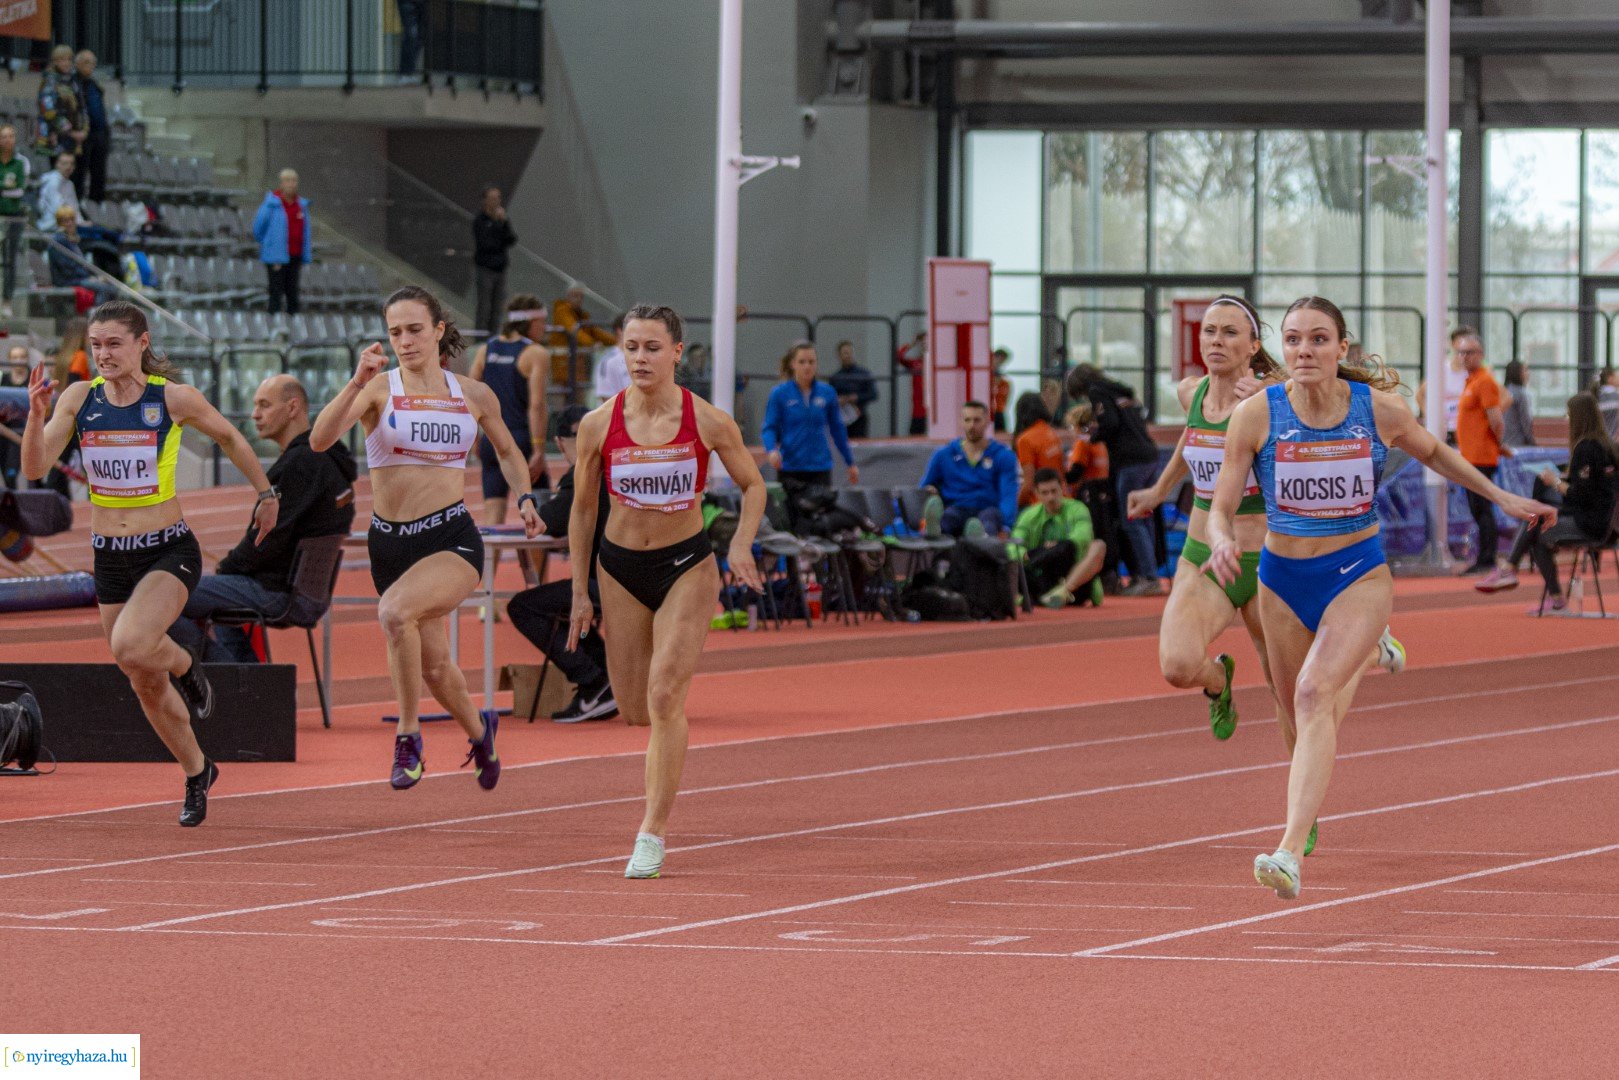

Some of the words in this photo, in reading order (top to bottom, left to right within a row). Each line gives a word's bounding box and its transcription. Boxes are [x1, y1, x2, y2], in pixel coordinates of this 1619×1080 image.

[411, 421, 461, 444] FODOR
[91, 459, 132, 480] NAGY
[136, 459, 149, 479] P.
[619, 470, 693, 496] SKRIVÁN
[1280, 476, 1346, 501] KOCSIS
[1351, 474, 1369, 498] A.
[398, 512, 443, 536] NIKE
[111, 530, 160, 551] NIKE
